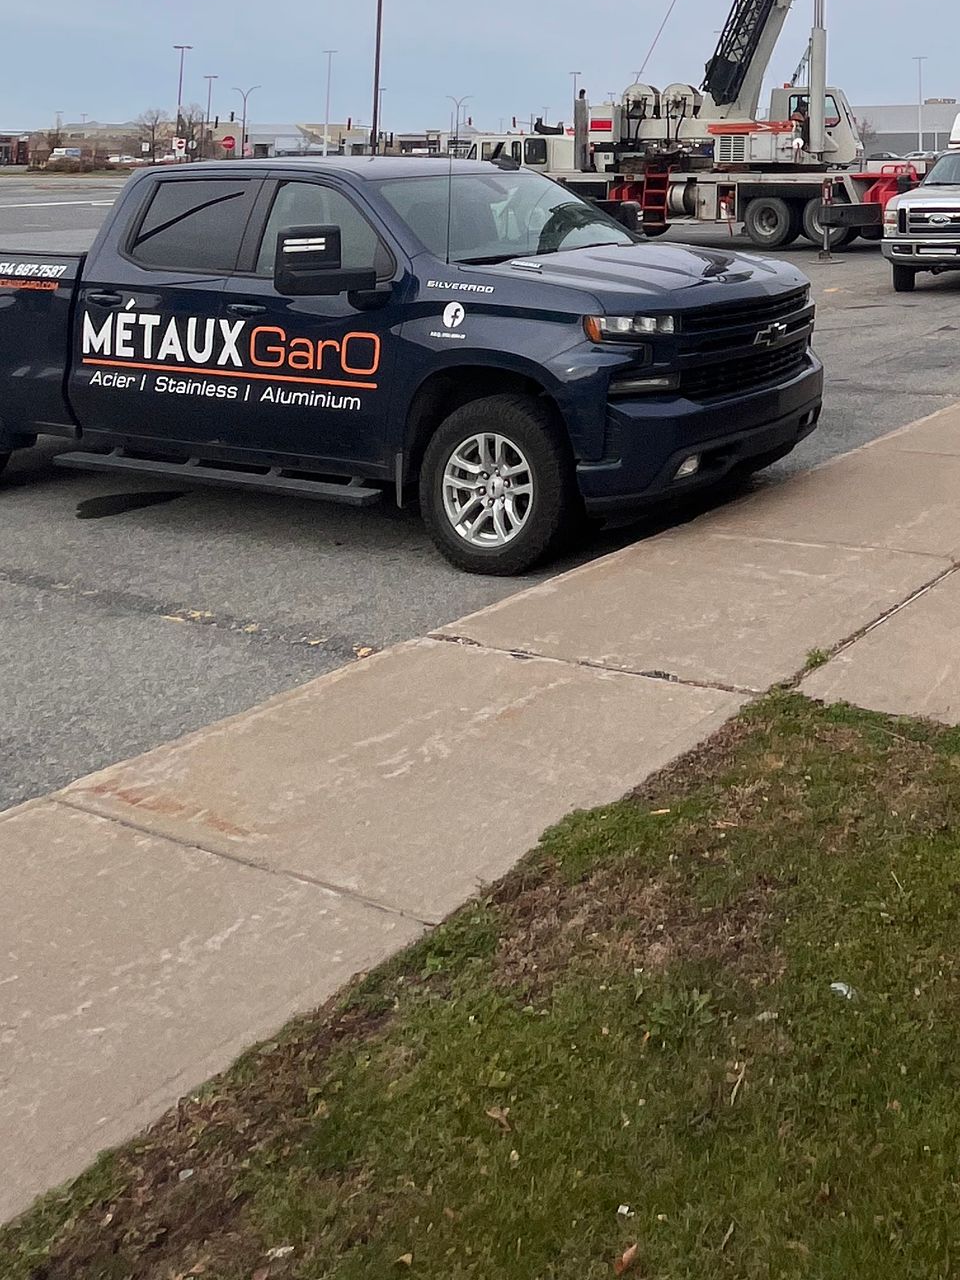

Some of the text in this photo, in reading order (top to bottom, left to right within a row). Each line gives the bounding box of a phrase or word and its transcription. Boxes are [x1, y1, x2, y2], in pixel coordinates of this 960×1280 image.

[14, 263, 68, 278] 887-7587
[427, 280, 494, 294] SILVERADO
[89, 370, 136, 389] Acier
[154, 376, 239, 399] Stainless
[259, 386, 361, 411] Aluminium
